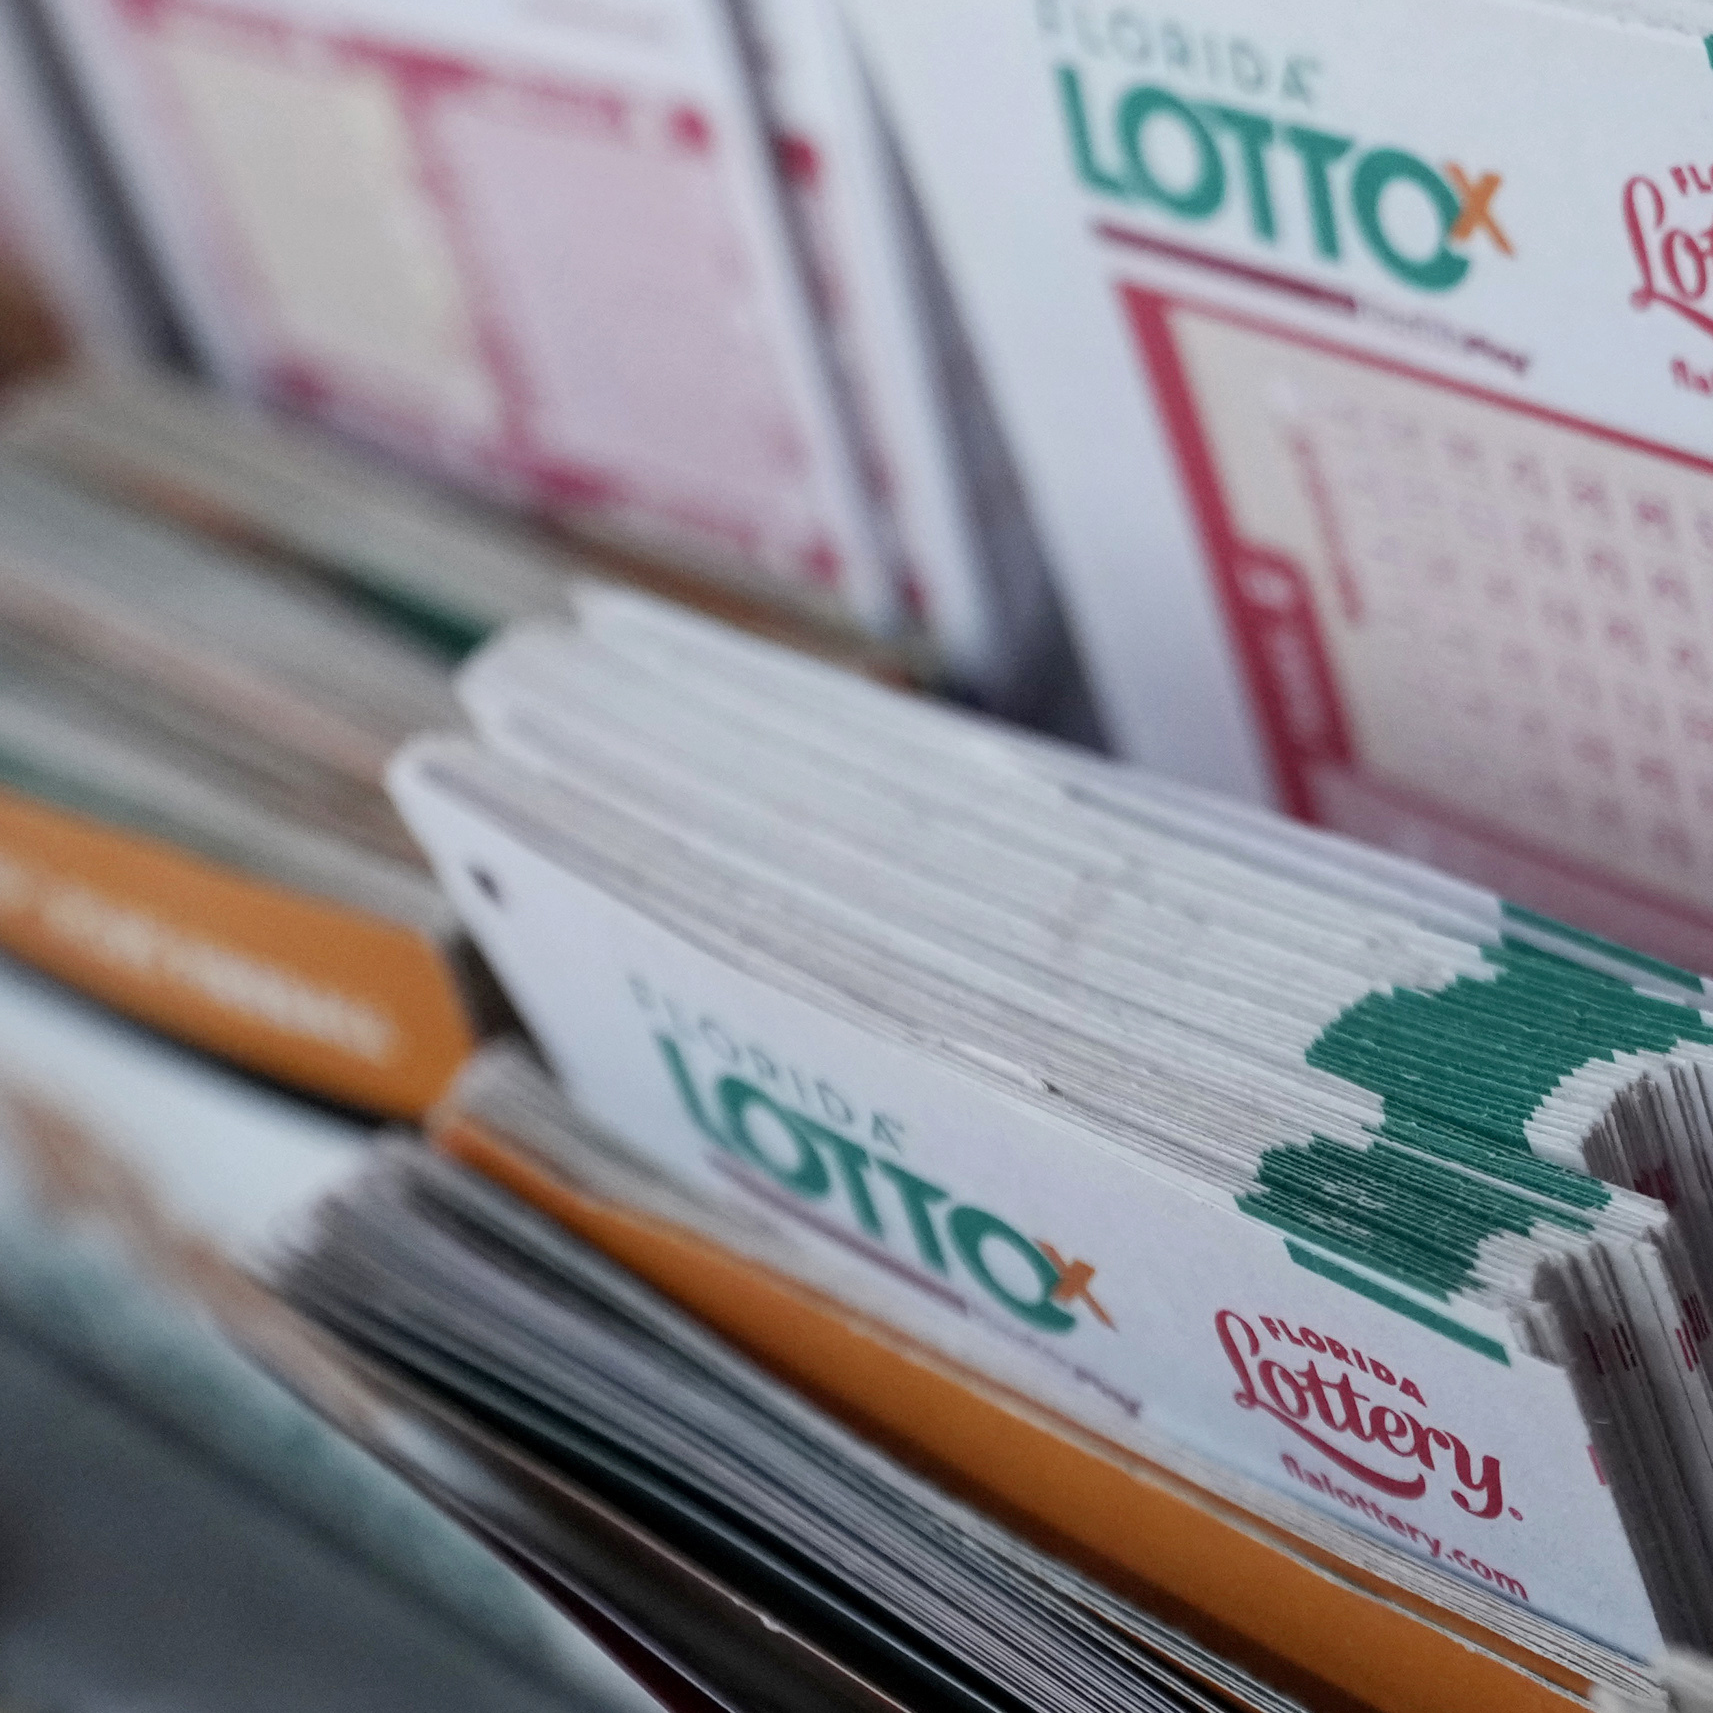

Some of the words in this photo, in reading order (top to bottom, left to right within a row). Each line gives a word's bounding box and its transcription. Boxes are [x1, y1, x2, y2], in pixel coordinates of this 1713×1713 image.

[1215, 1308, 1507, 1522] Lottery
[1258, 1315, 1428, 1410] FLORIDA
[1282, 1453, 1529, 1603] flalottery.com
